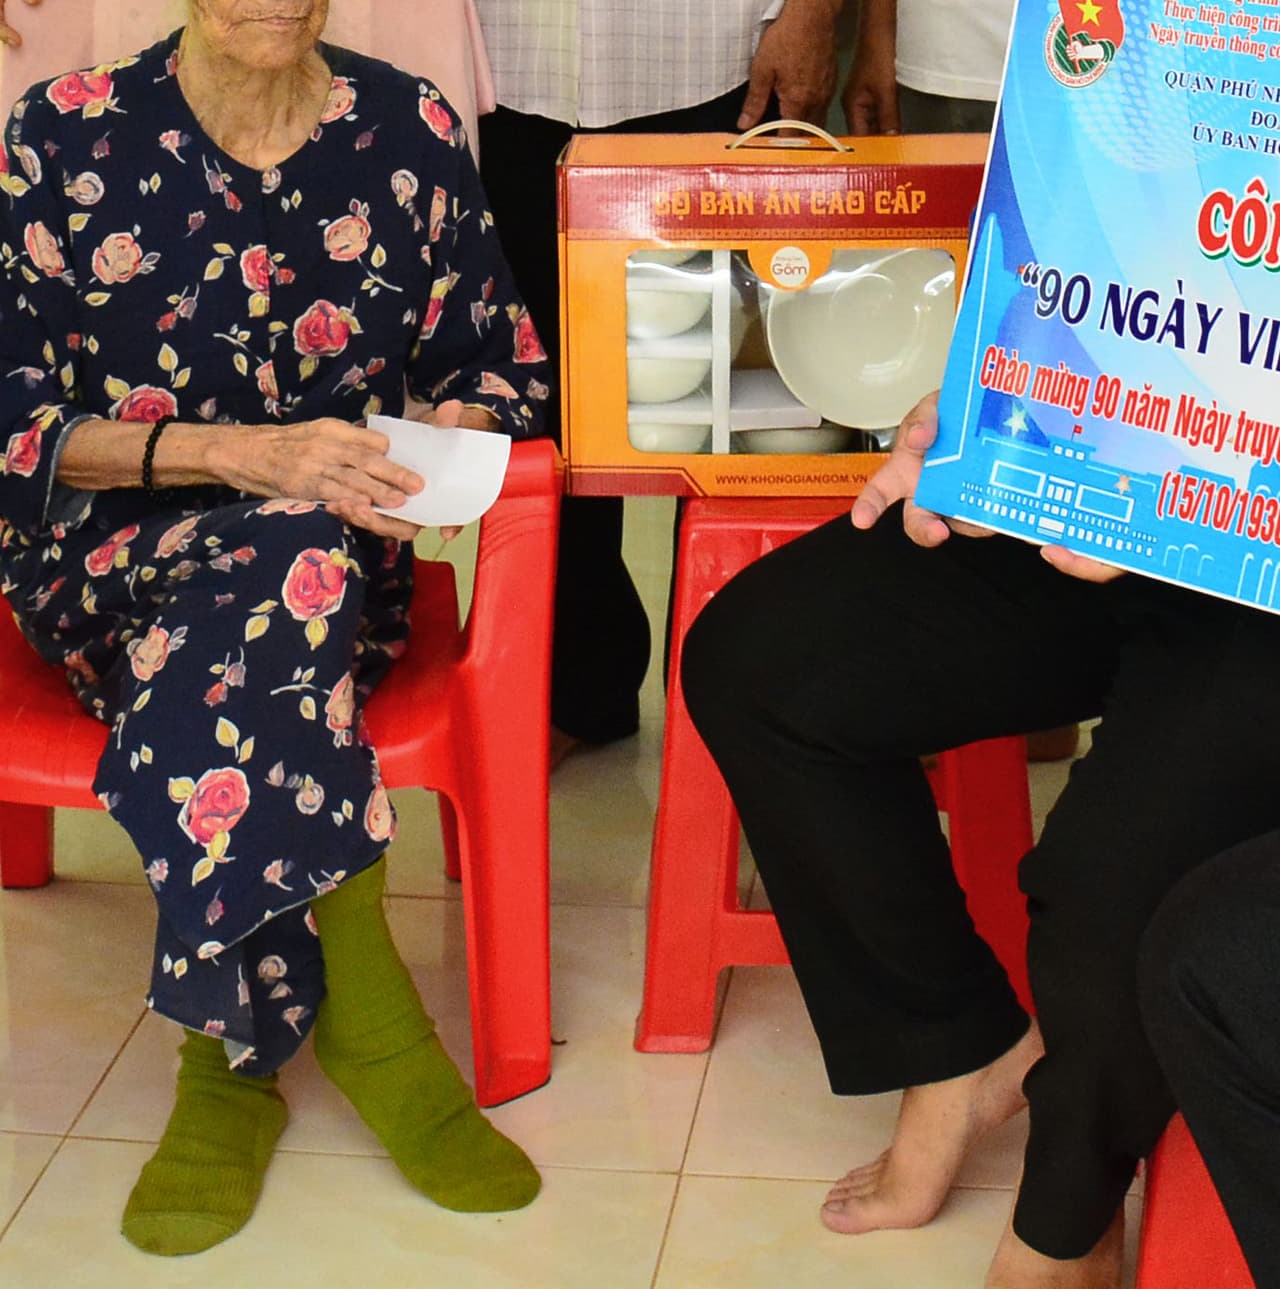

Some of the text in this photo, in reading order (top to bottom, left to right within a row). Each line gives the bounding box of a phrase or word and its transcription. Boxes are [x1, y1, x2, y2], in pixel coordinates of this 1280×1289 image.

[1163, 0, 1195, 19] Thực
[1199, 4, 1225, 24] hiện
[1229, 8, 1259, 32] công
[1149, 23, 1181, 46] Ngày
[1184, 27, 1225, 51] truyền
[1229, 33, 1267, 60] thống
[1164, 70, 1216, 93] QUẬN
[1220, 79, 1258, 99] PHÚ
[1222, 131, 1259, 151] BAN
[700, 187, 754, 216] BÀN
[810, 191, 865, 215] CAO
[875, 182, 926, 215] CẤP
[1099, 279, 1223, 355] NGÀY
[979, 345, 1030, 396] Chào
[1031, 362, 1090, 417] mừng
[1092, 374, 1121, 420] 90
[1123, 383, 1172, 434] năm
[1171, 393, 1231, 456] Ngày
